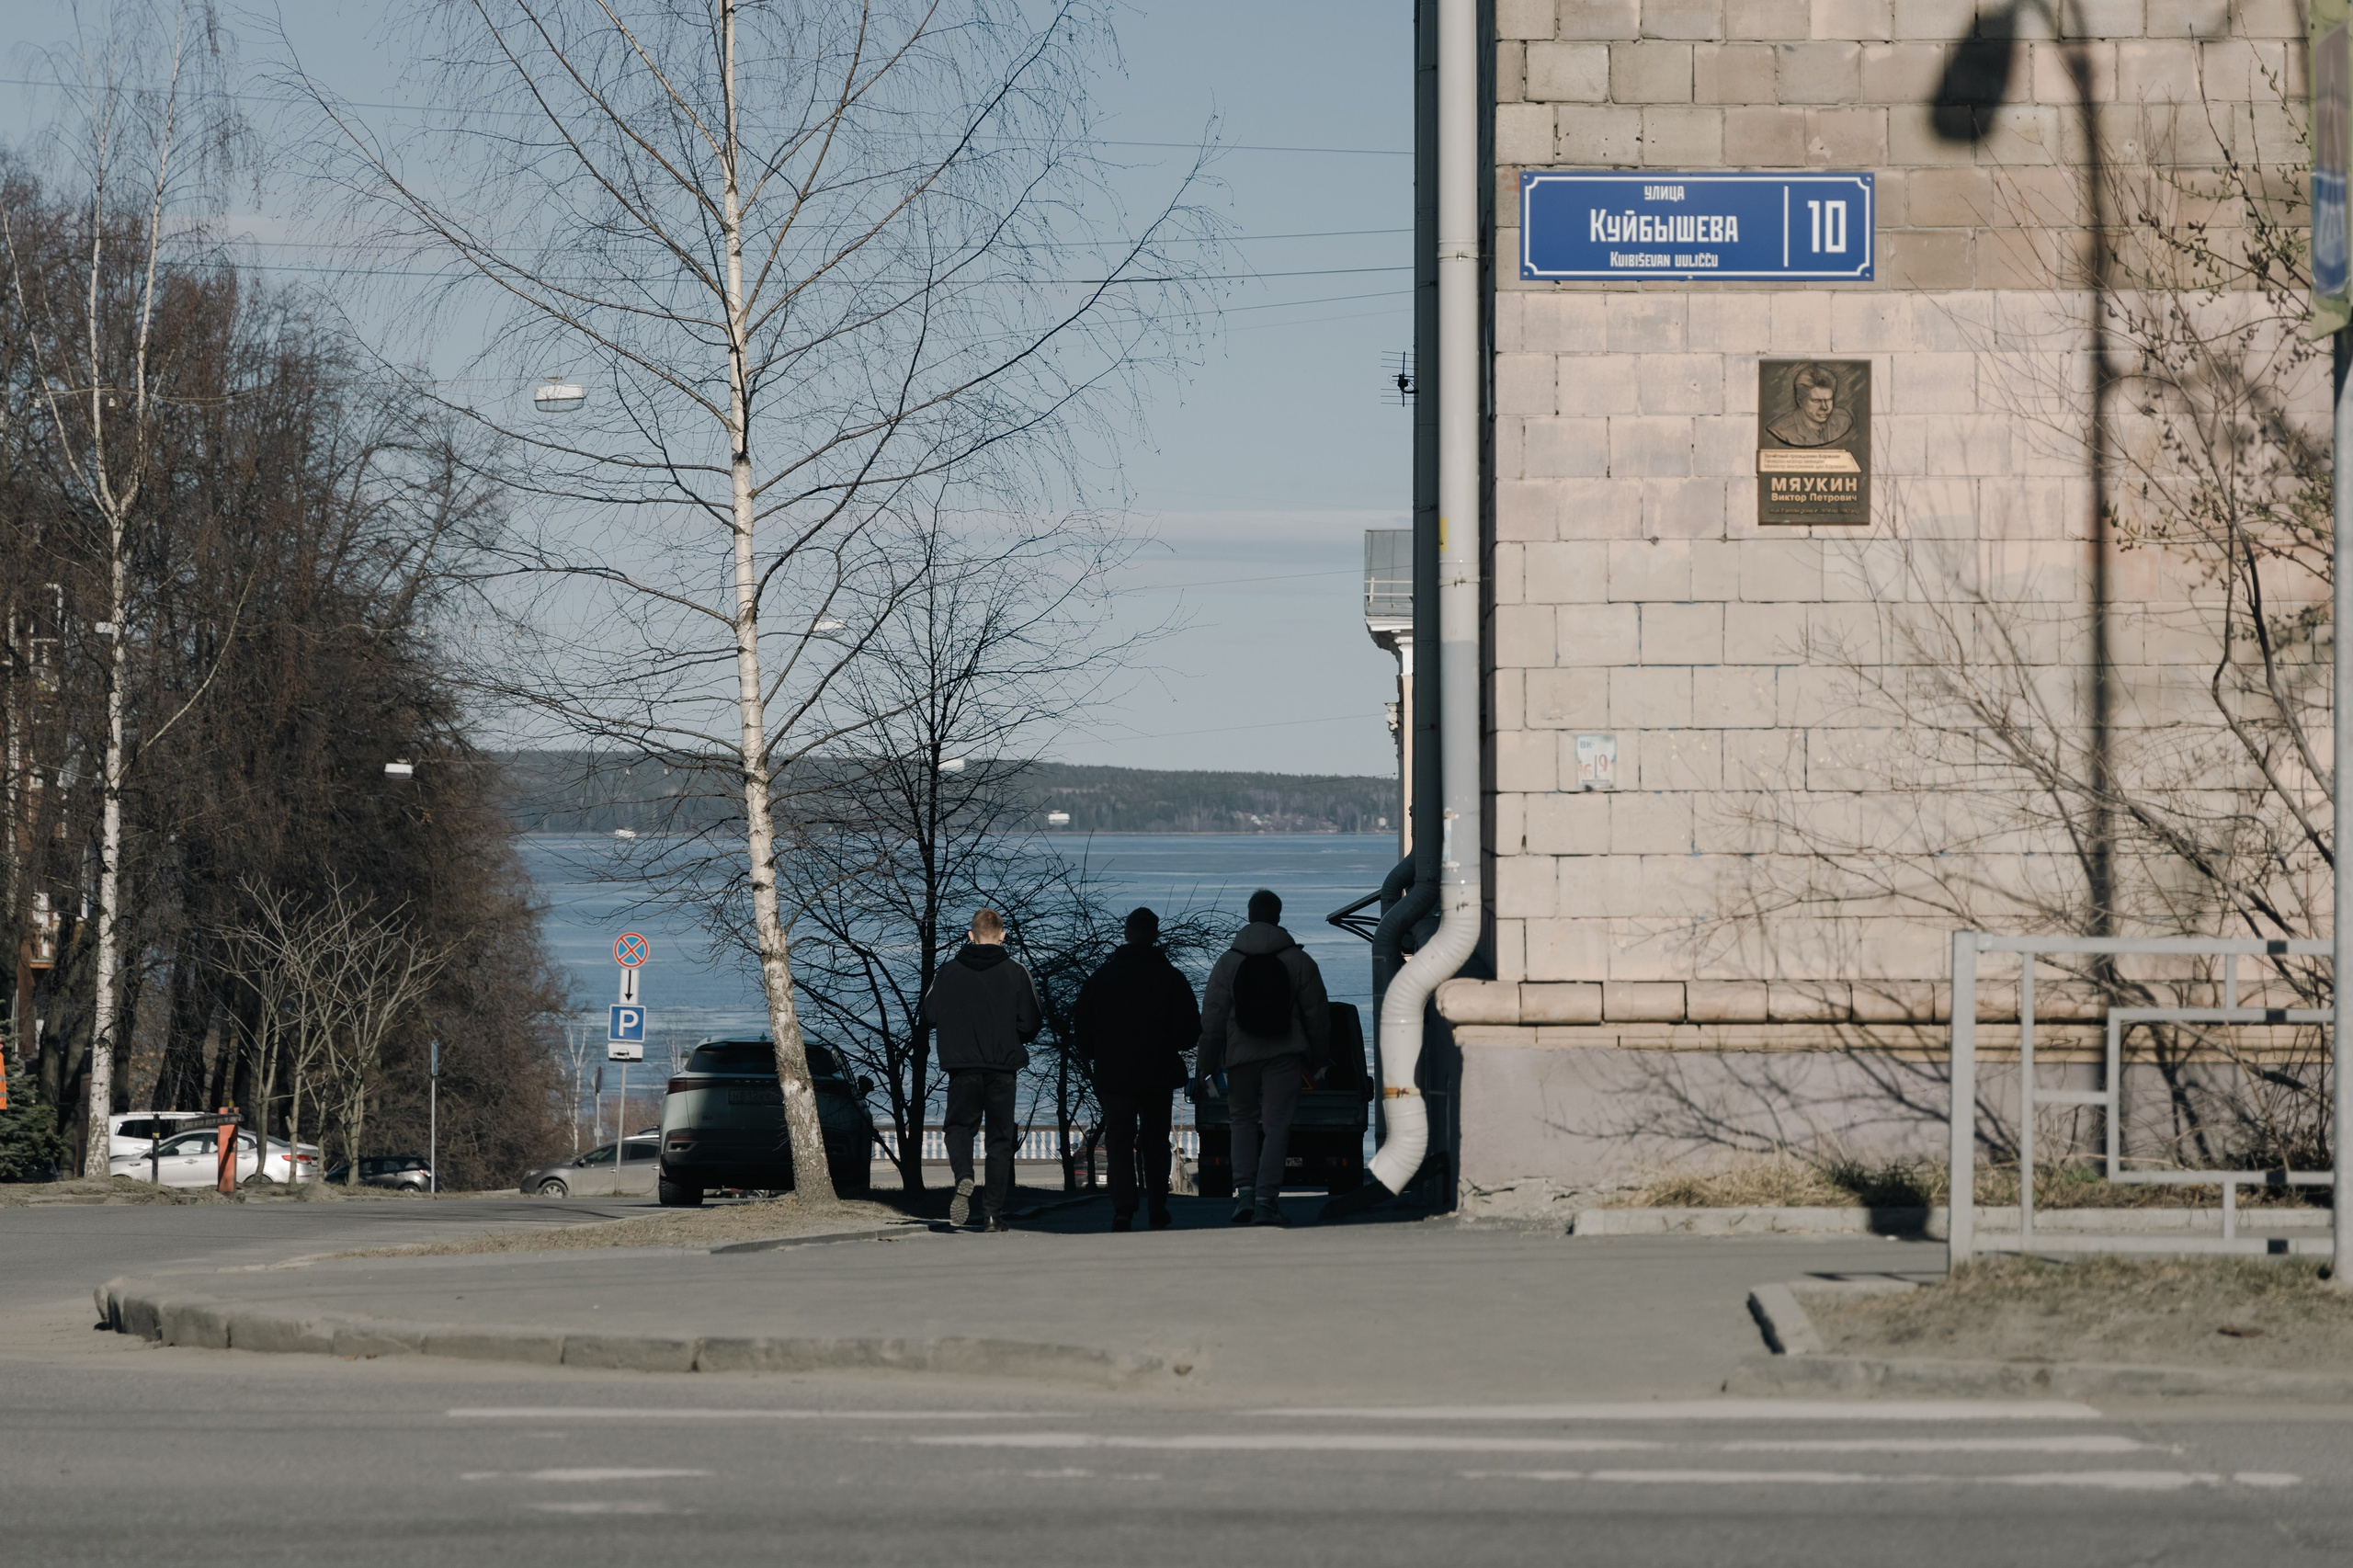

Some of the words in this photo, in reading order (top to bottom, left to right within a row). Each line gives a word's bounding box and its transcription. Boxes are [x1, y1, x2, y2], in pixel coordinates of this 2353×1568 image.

[1643, 185, 1686, 202] УЛИЦА
[1590, 209, 1739, 243] КУЙБЫШЕВА
[1807, 200, 1847, 253] 10
[1771, 477, 1858, 492] МЯУКИН
[1771, 493, 1807, 503] Виктор
[1809, 493, 1858, 503] Петрович
[618, 1009, 639, 1037] P
